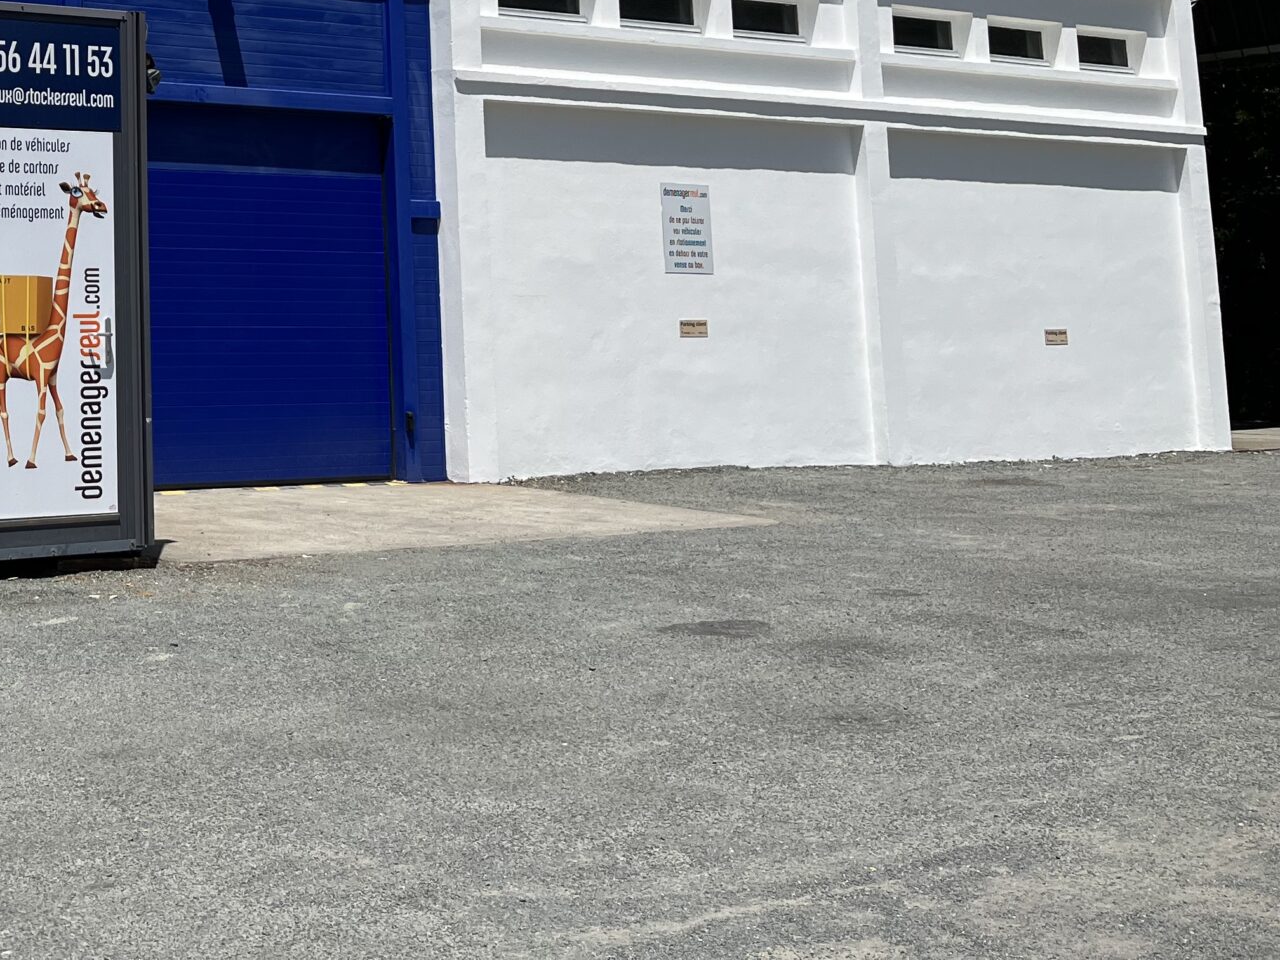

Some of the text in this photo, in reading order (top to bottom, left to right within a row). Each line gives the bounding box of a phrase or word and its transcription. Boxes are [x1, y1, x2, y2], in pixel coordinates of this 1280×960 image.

[28, 42, 57, 75] 44
[62, 43, 80, 76] 11
[87, 45, 114, 78] 53
[10, 136, 23, 151] de
[25, 135, 70, 153] véhicules
[8, 159, 21, 174] de
[23, 160, 59, 174] cartons
[5, 181, 46, 197] matériel
[73, 267, 108, 499] demenagerseul.com
